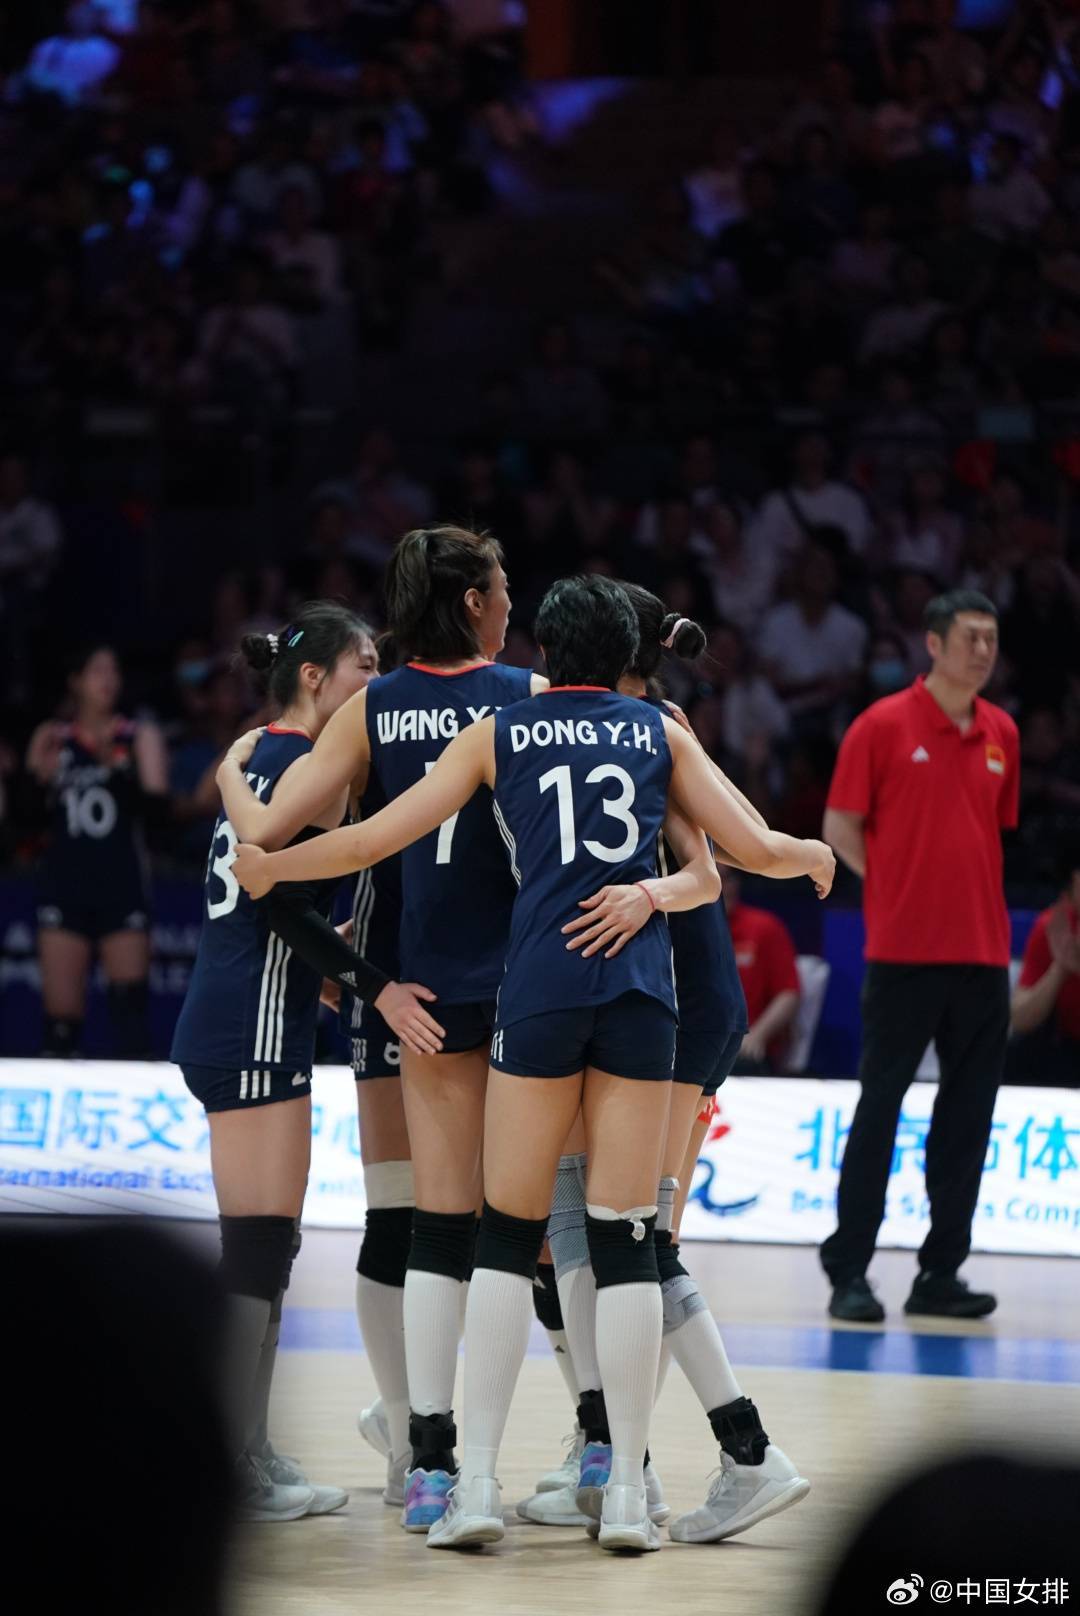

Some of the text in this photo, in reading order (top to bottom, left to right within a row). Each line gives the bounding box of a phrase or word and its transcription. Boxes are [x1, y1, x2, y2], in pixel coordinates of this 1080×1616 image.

[377, 705, 503, 745] WANG Y
[510, 720, 657, 755] DONG Y.H.
[62, 787, 117, 838] 10
[539, 764, 639, 865] 13
